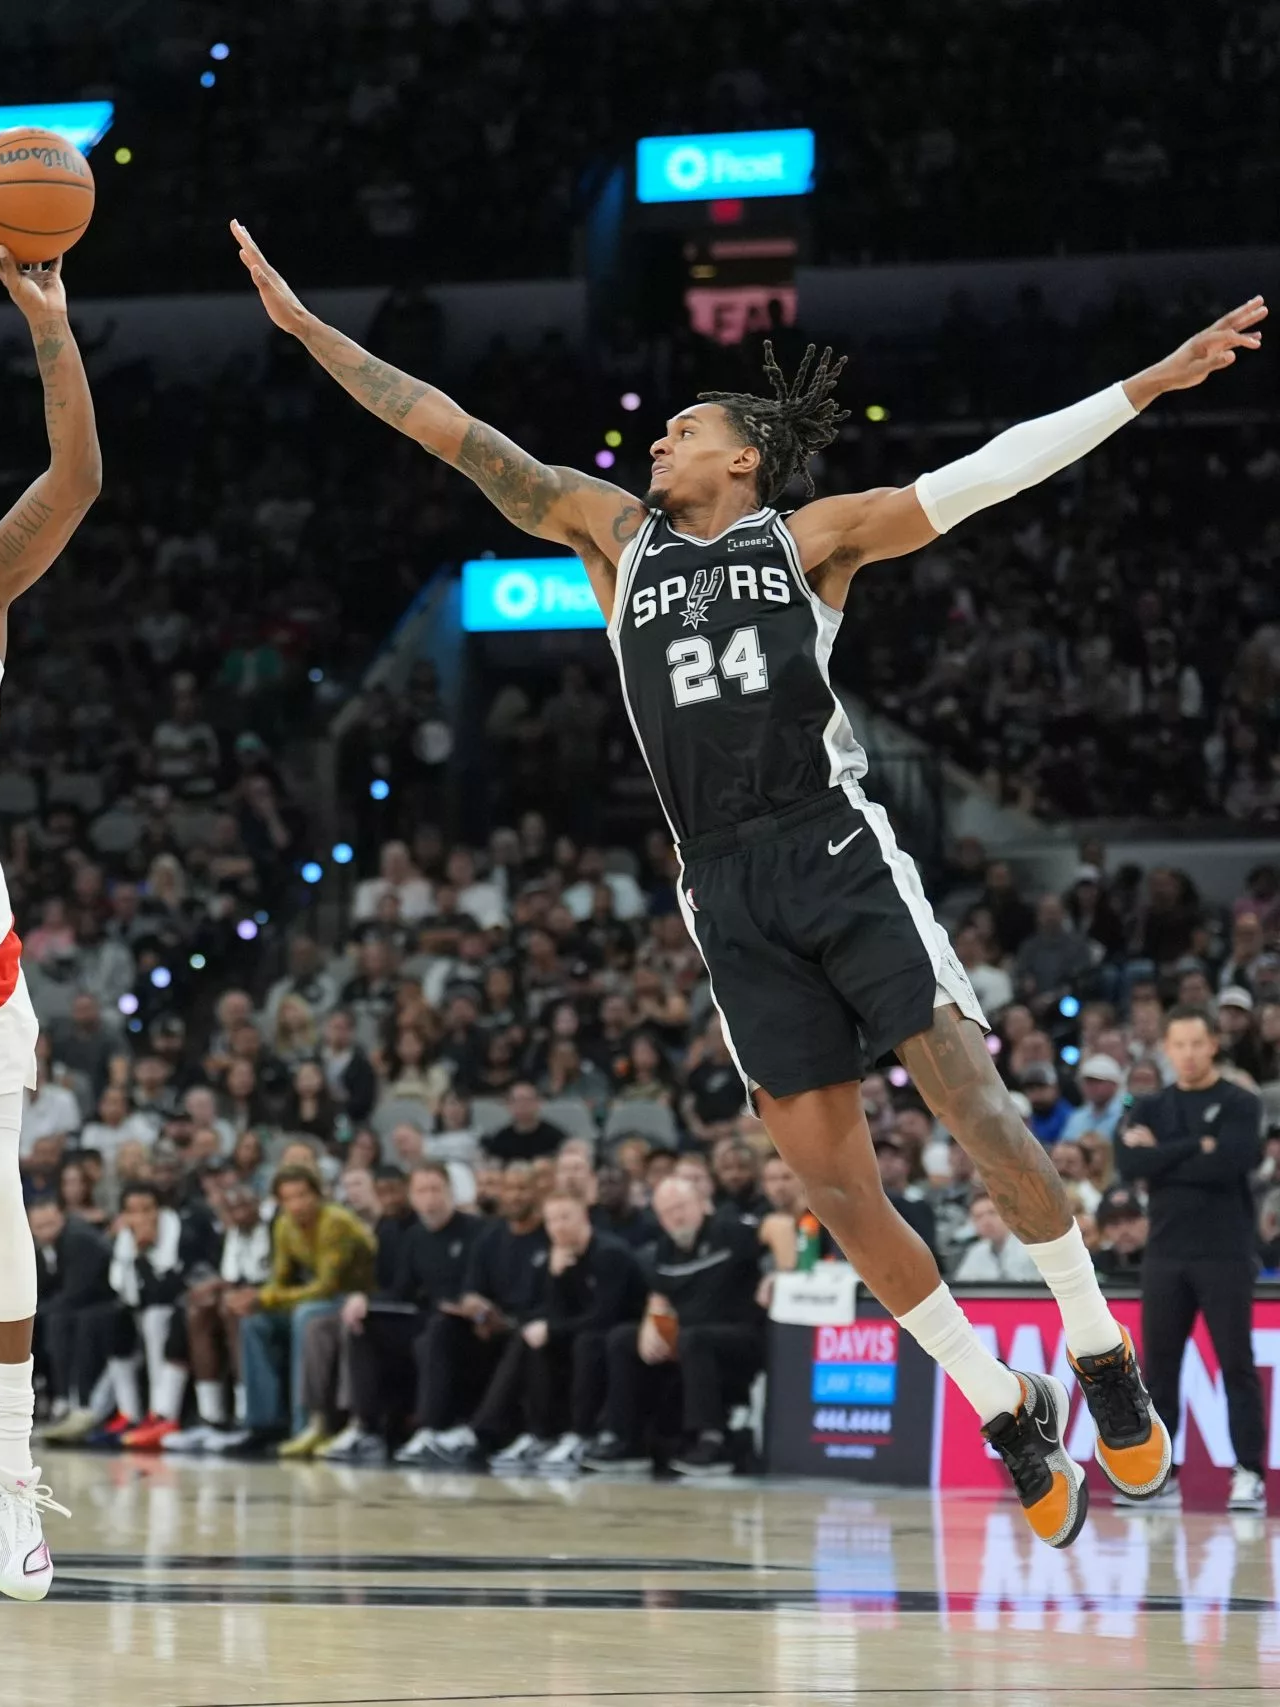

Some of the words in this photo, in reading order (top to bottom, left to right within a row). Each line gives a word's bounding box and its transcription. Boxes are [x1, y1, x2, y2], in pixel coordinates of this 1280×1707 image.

[711, 149, 783, 183] Frost
[733, 538, 768, 549] LEDGER
[541, 577, 597, 612] Fro
[632, 565, 791, 630] SPURS
[666, 625, 769, 708] 24
[816, 1326, 895, 1361] DAVIS
